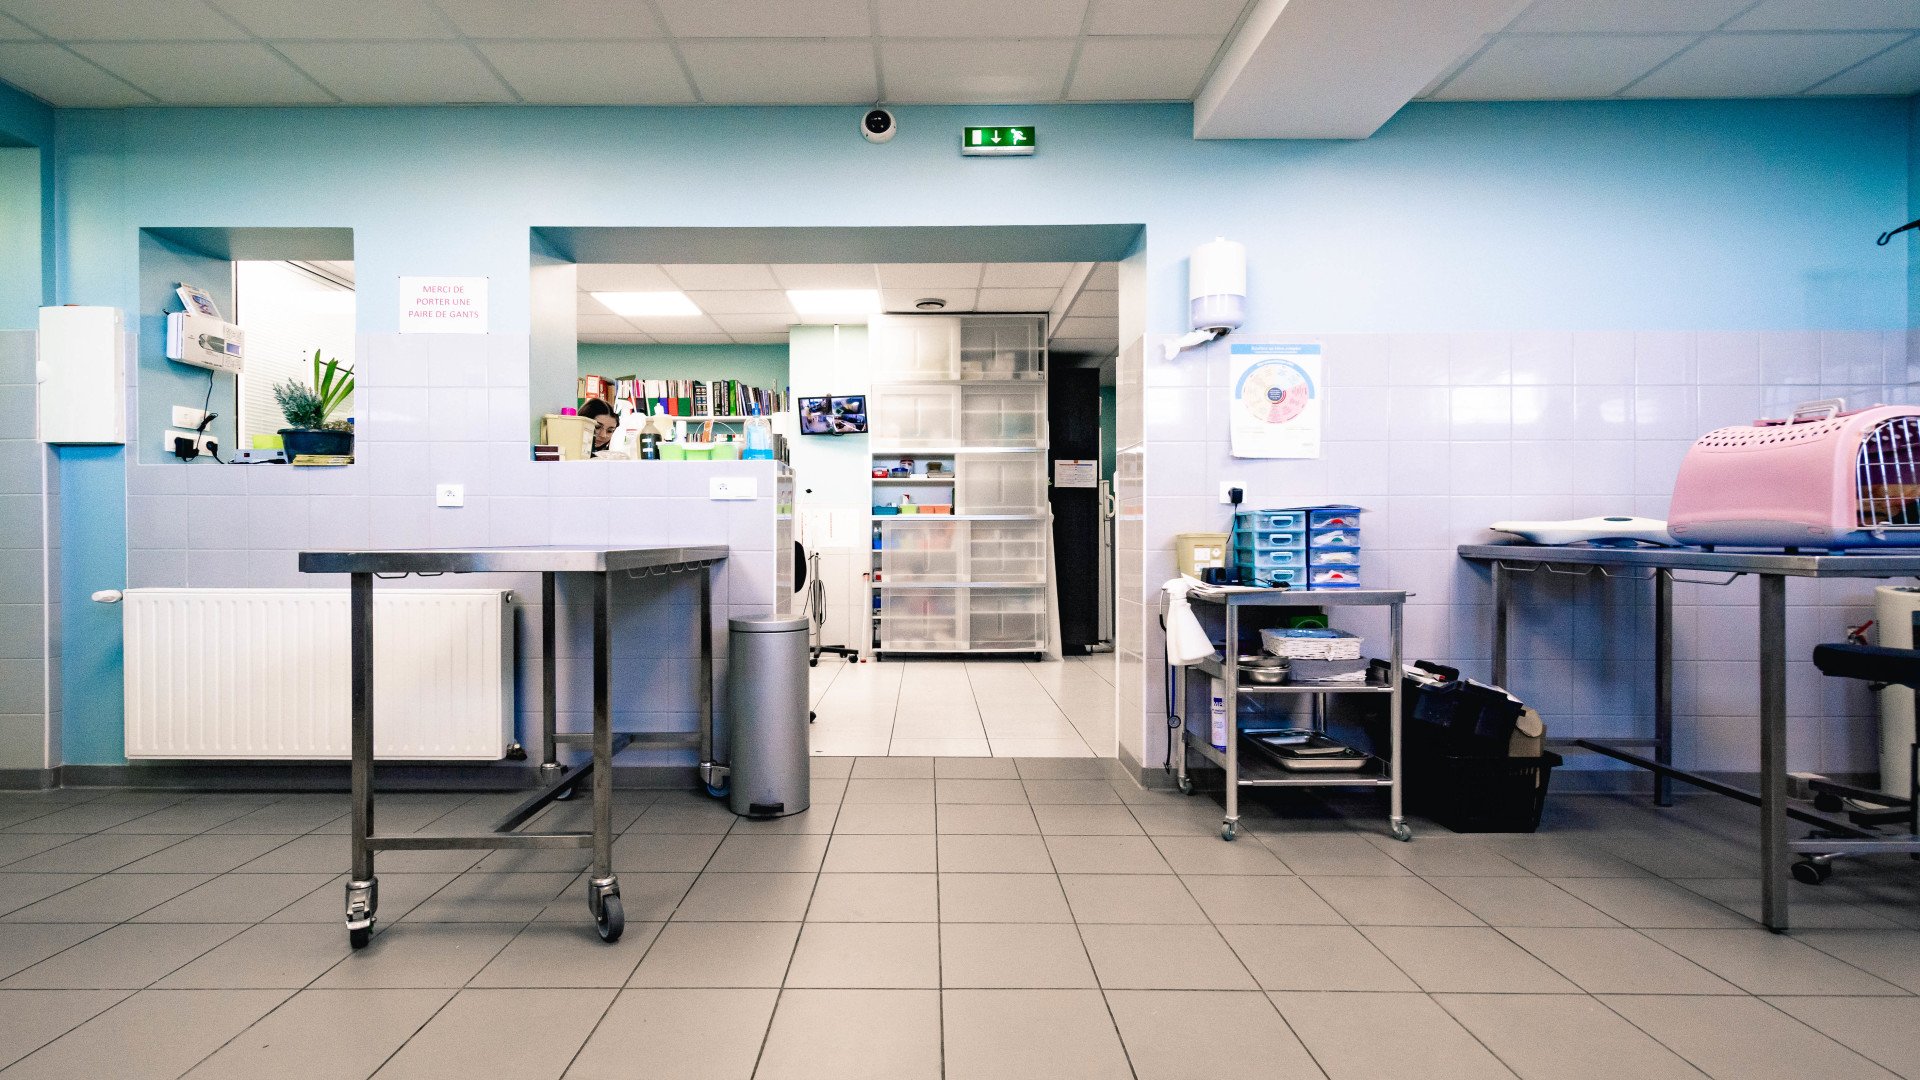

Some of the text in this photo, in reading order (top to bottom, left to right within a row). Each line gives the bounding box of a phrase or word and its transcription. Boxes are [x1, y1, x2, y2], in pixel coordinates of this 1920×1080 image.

[422, 285, 464, 293] MERCI DE
[408, 310, 479, 319] PAIRE DE GANTS
